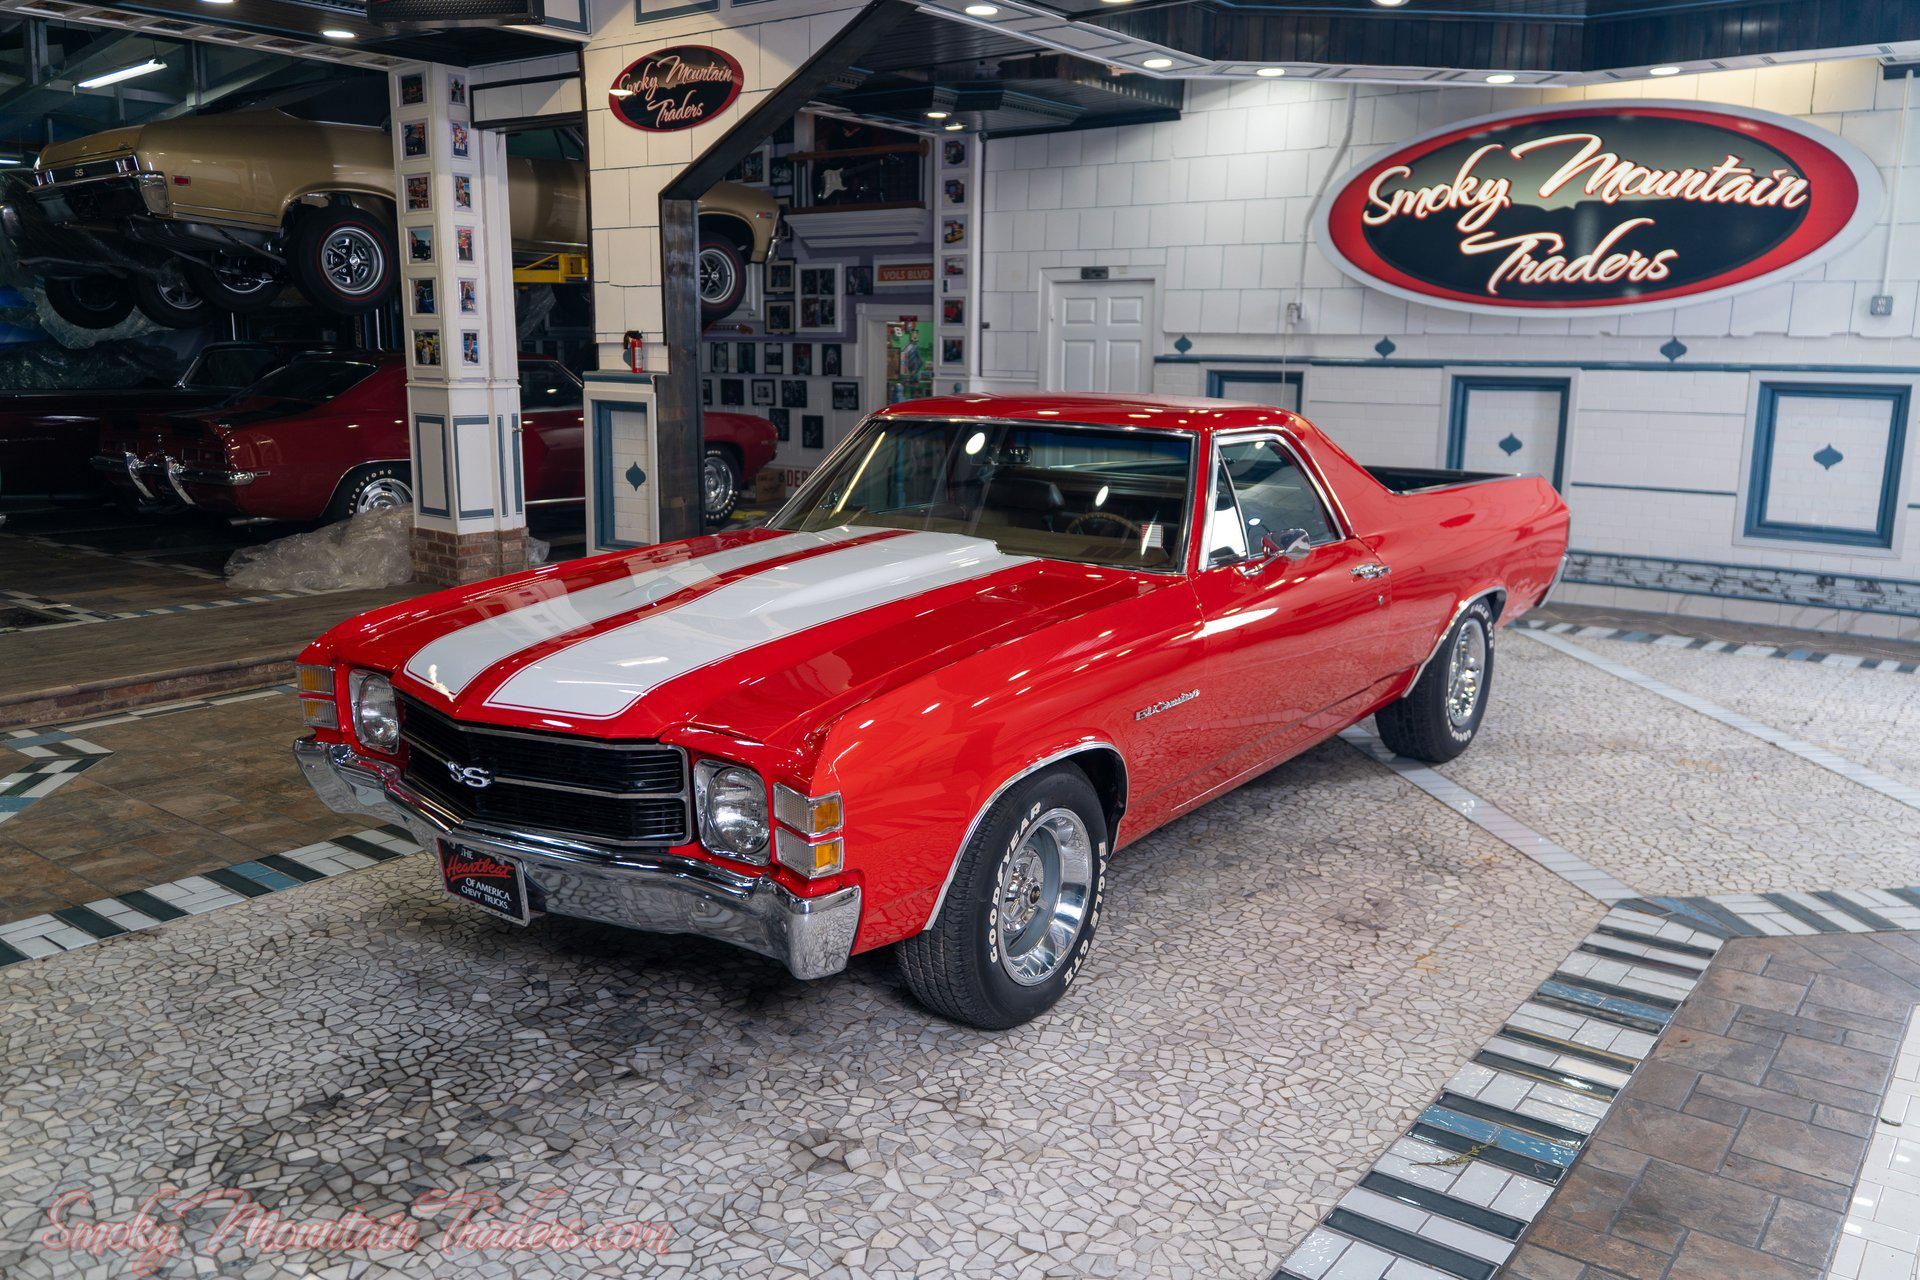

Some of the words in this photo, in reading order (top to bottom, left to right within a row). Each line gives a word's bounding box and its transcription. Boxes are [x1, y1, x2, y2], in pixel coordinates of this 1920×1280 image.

[618, 61, 659, 101] Smoky
[656, 55, 733, 84] Mountain
[646, 89, 705, 128] Traders
[74, 168, 84, 177] SS
[1361, 143, 1511, 232] Smoky
[1510, 133, 1810, 210] Mountain
[1460, 217, 1679, 295] Traders
[883, 269, 905, 281] VOLS
[907, 269, 930, 280] BLVD
[1153, 688, 1201, 713] Camino
[447, 761, 492, 788] SS
[447, 854, 515, 877] Heartbeat
[460, 848, 474, 860] THE
[461, 886, 482, 899] CHEVY
[465, 877, 476, 888] OF
[988, 801, 1042, 964] GOODYEAR
[1089, 841, 1108, 927] EAGLE
